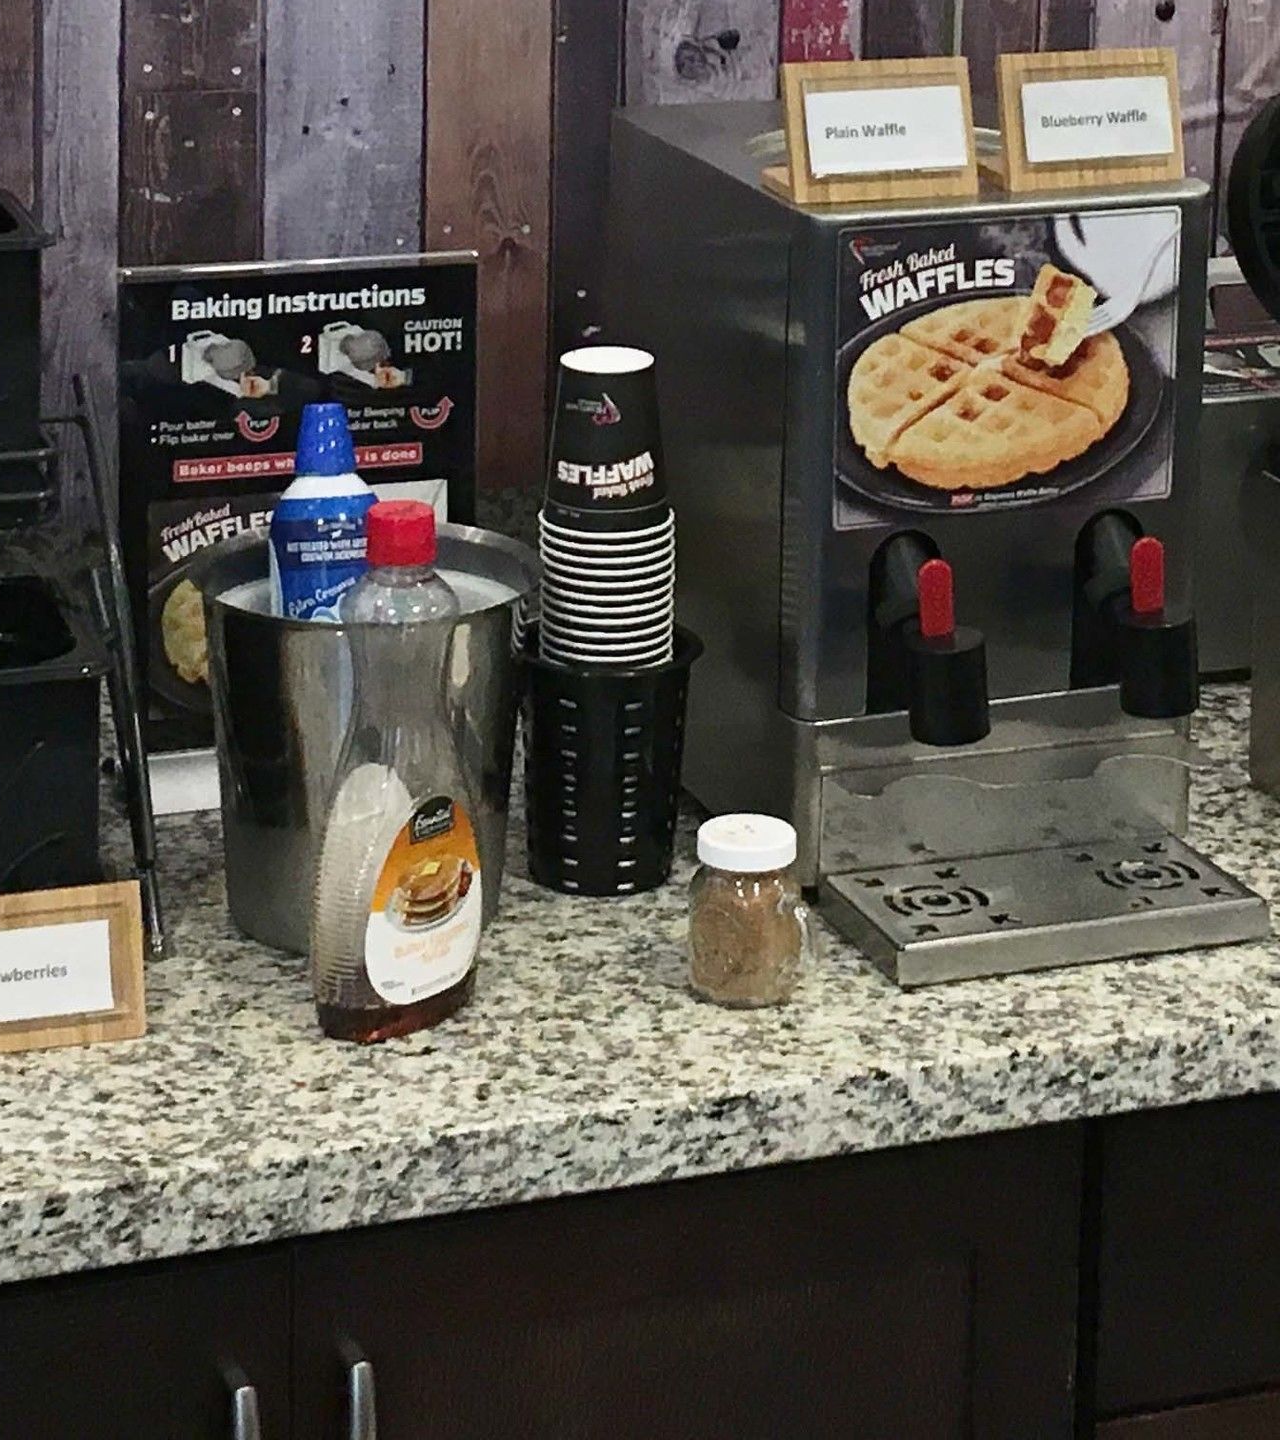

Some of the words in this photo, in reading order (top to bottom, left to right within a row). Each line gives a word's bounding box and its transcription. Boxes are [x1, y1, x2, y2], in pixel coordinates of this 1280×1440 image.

[1040, 113, 1103, 129] Blueberry
[1106, 110, 1148, 124] Waffle
[824, 126, 860, 140] Plain
[862, 123, 907, 138] Waffle
[859, 259, 904, 291] Fresh
[906, 243, 956, 272] Baked
[859, 259, 1016, 321] WAFFLES
[171, 293, 263, 321] Baking
[268, 284, 426, 315] Instructions
[404, 318, 463, 332] CAUTION
[300, 335, 313, 355] 2
[404, 331, 463, 354] HOT!
[168, 344, 177, 363] 1
[365, 451, 378, 462] is
[382, 449, 418, 461] done
[179, 463, 223, 477] Baker
[227, 459, 271, 473] beeps
[557, 451, 655, 486] WAFFLES
